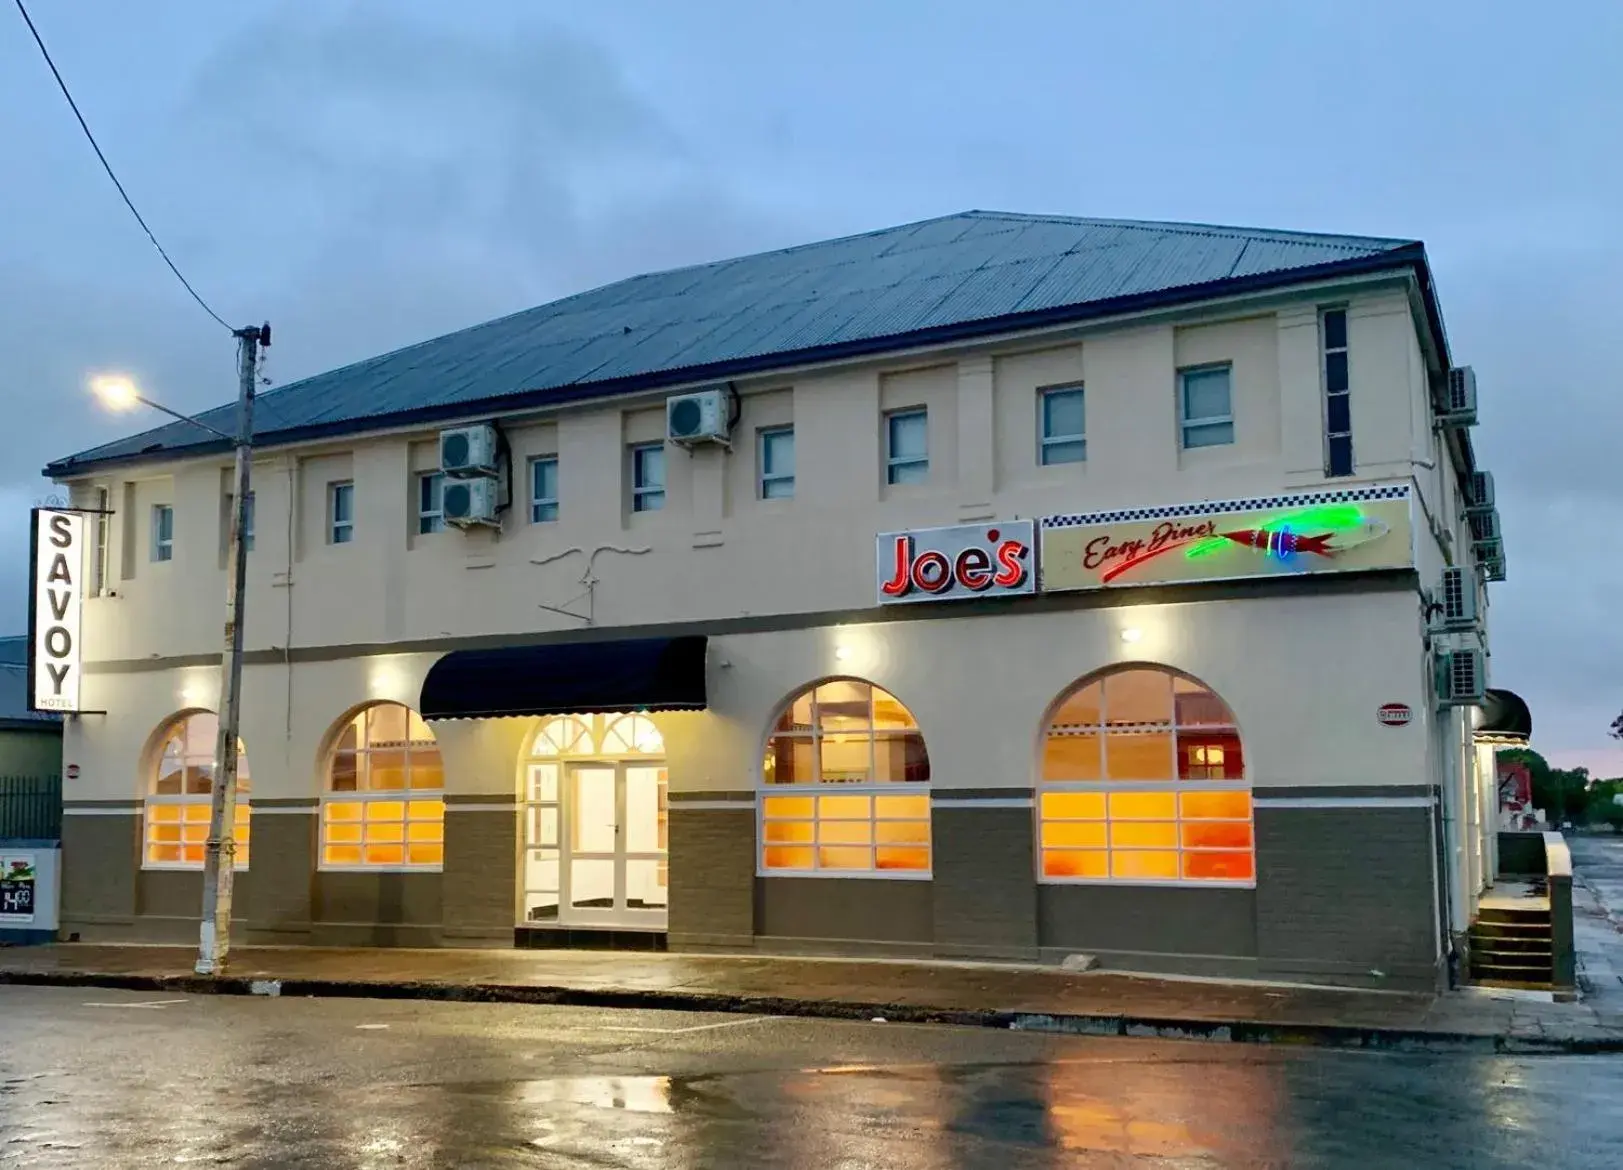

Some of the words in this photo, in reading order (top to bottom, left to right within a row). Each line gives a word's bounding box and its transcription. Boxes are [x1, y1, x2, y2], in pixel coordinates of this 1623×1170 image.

[882, 529, 1028, 597] Joe's
[1083, 535, 1145, 570] Easy
[1150, 521, 1215, 550] Diner
[44, 515, 73, 695] SAVOY
[40, 698, 73, 708] HOTEL
